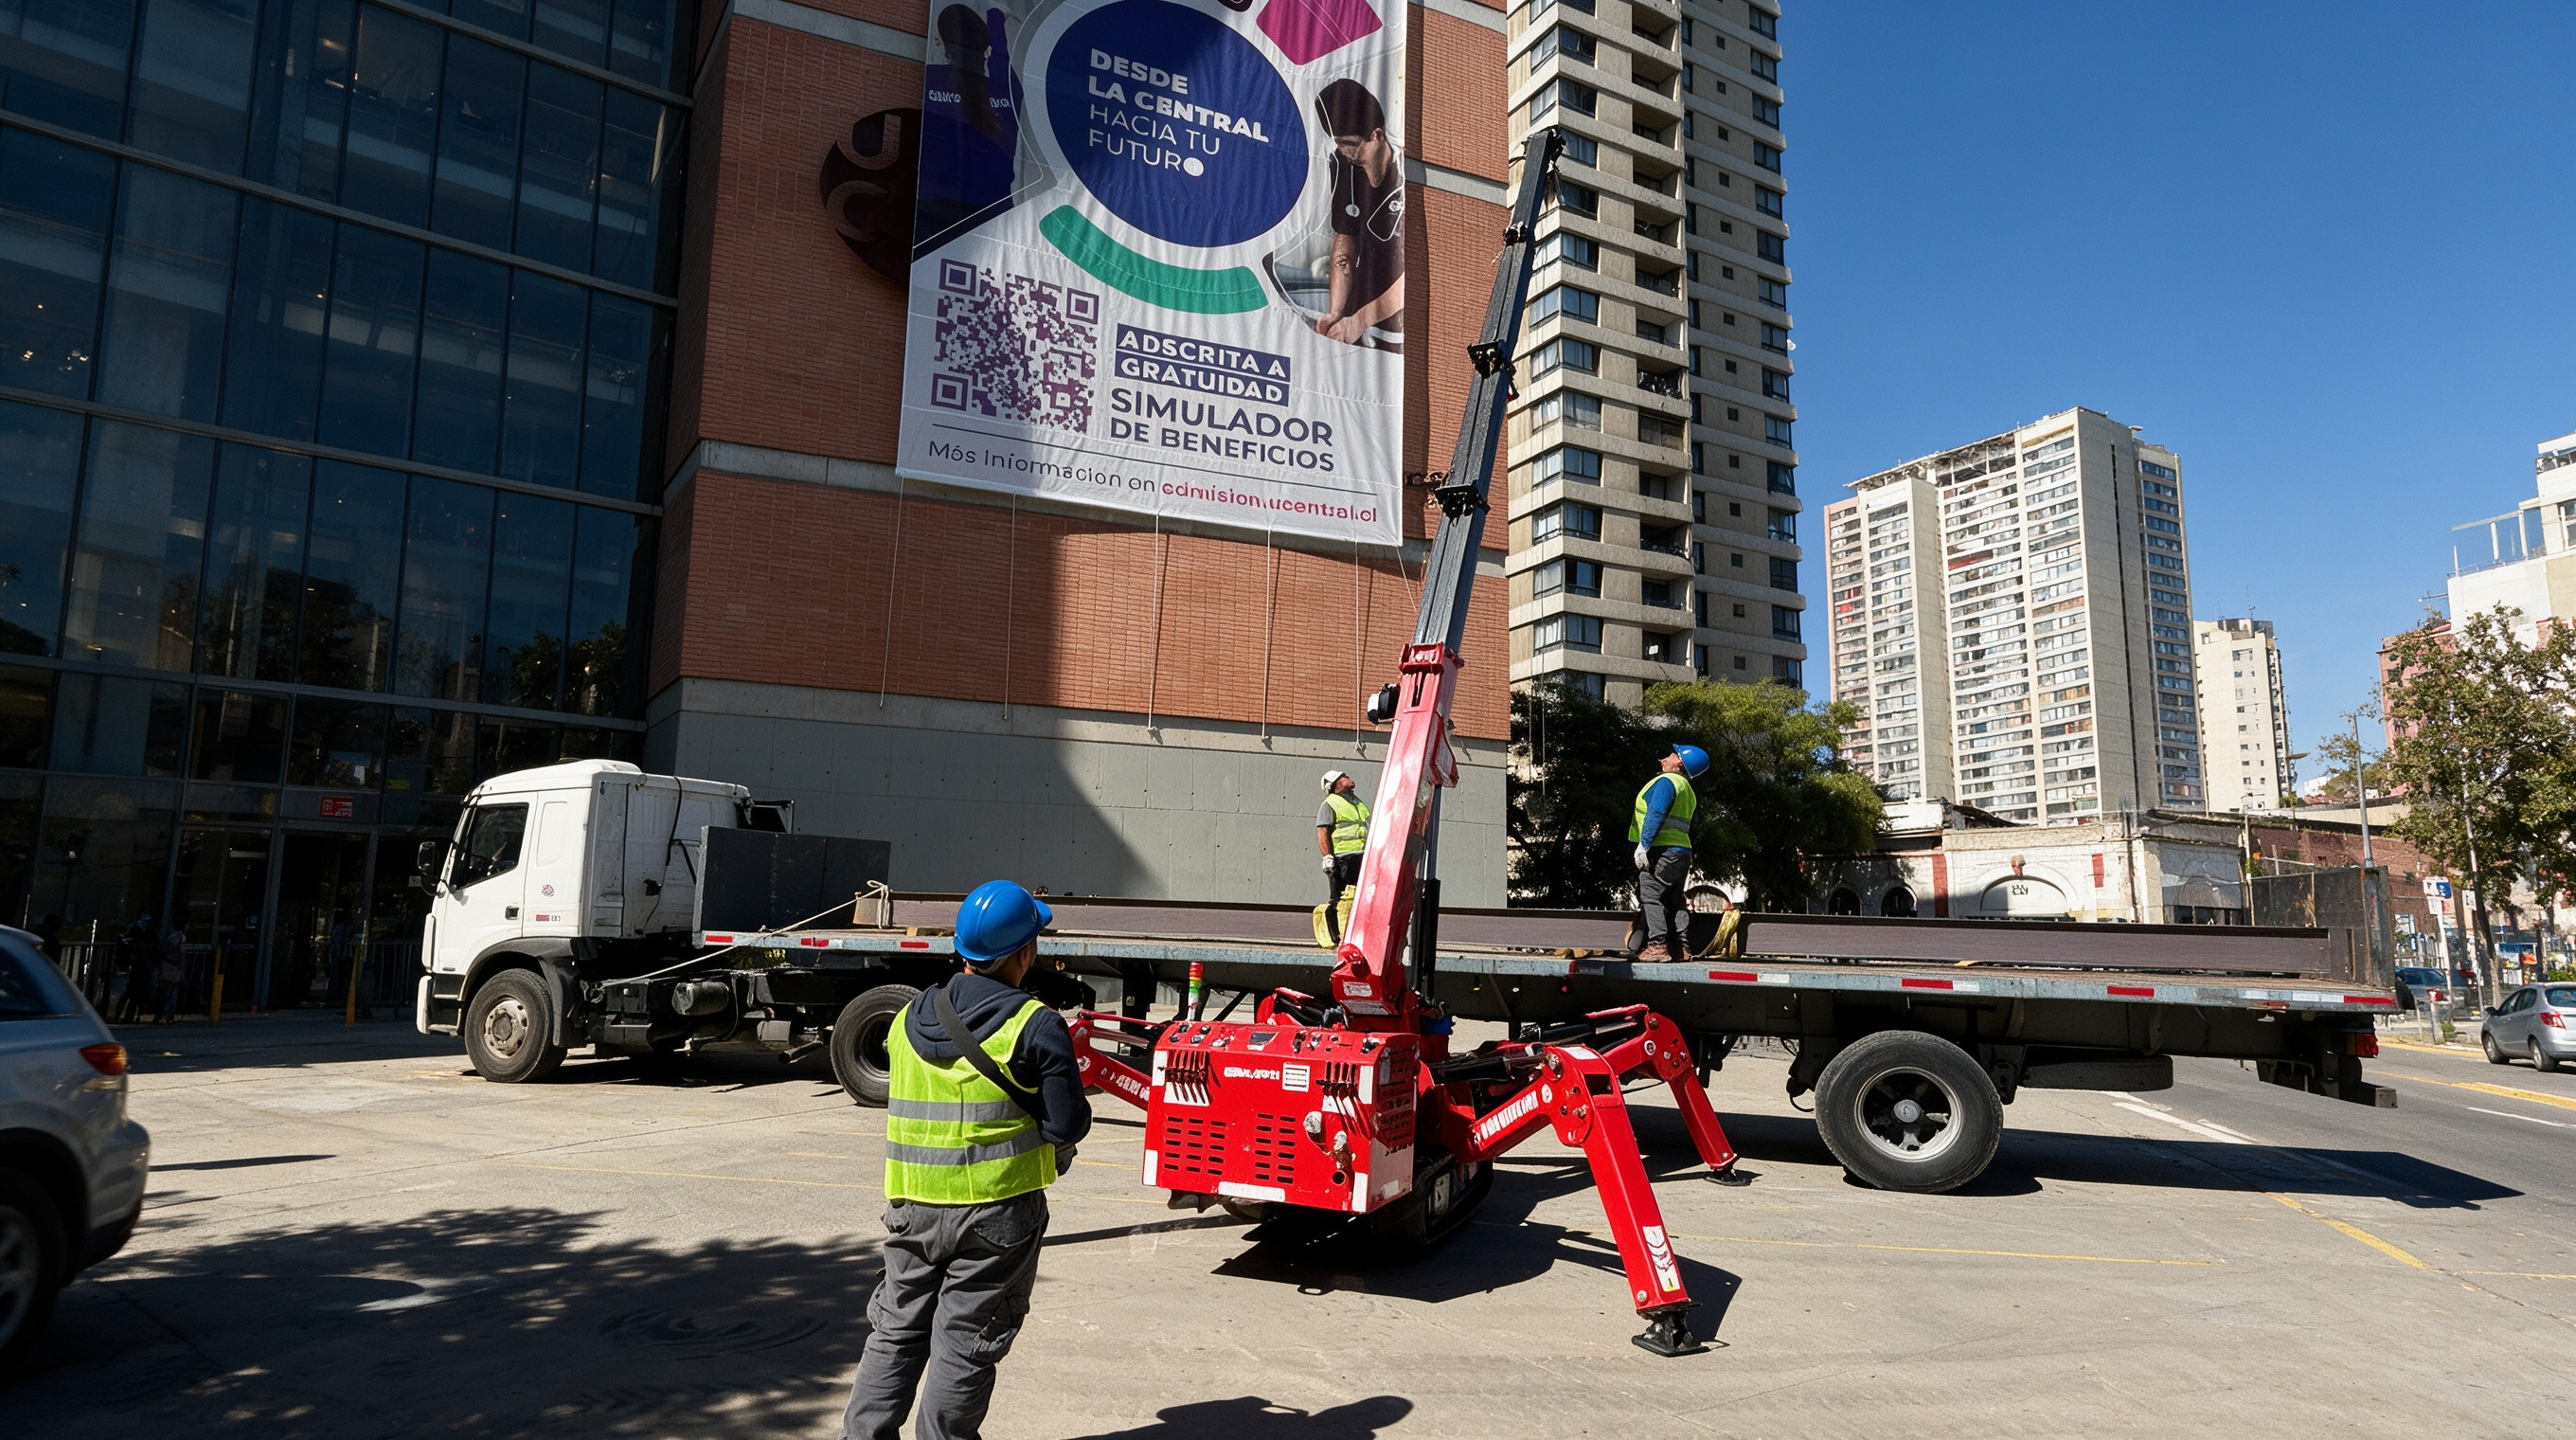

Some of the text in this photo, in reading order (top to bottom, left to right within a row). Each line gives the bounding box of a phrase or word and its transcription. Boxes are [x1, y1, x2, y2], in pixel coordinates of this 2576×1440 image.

[1090, 47, 1189, 95] DESDE
[1088, 75, 1270, 143] LA CENTRAL
[1090, 103, 1221, 155] HACIA TU
[1089, 128, 1205, 177] FUTURO
[1118, 331, 1286, 378] ADSCRITA A
[1120, 357, 1283, 403] GRATUIDAD
[1110, 387, 1333, 447] SIMULADOR
[1110, 416, 1334, 473] DE BENEFICIOS
